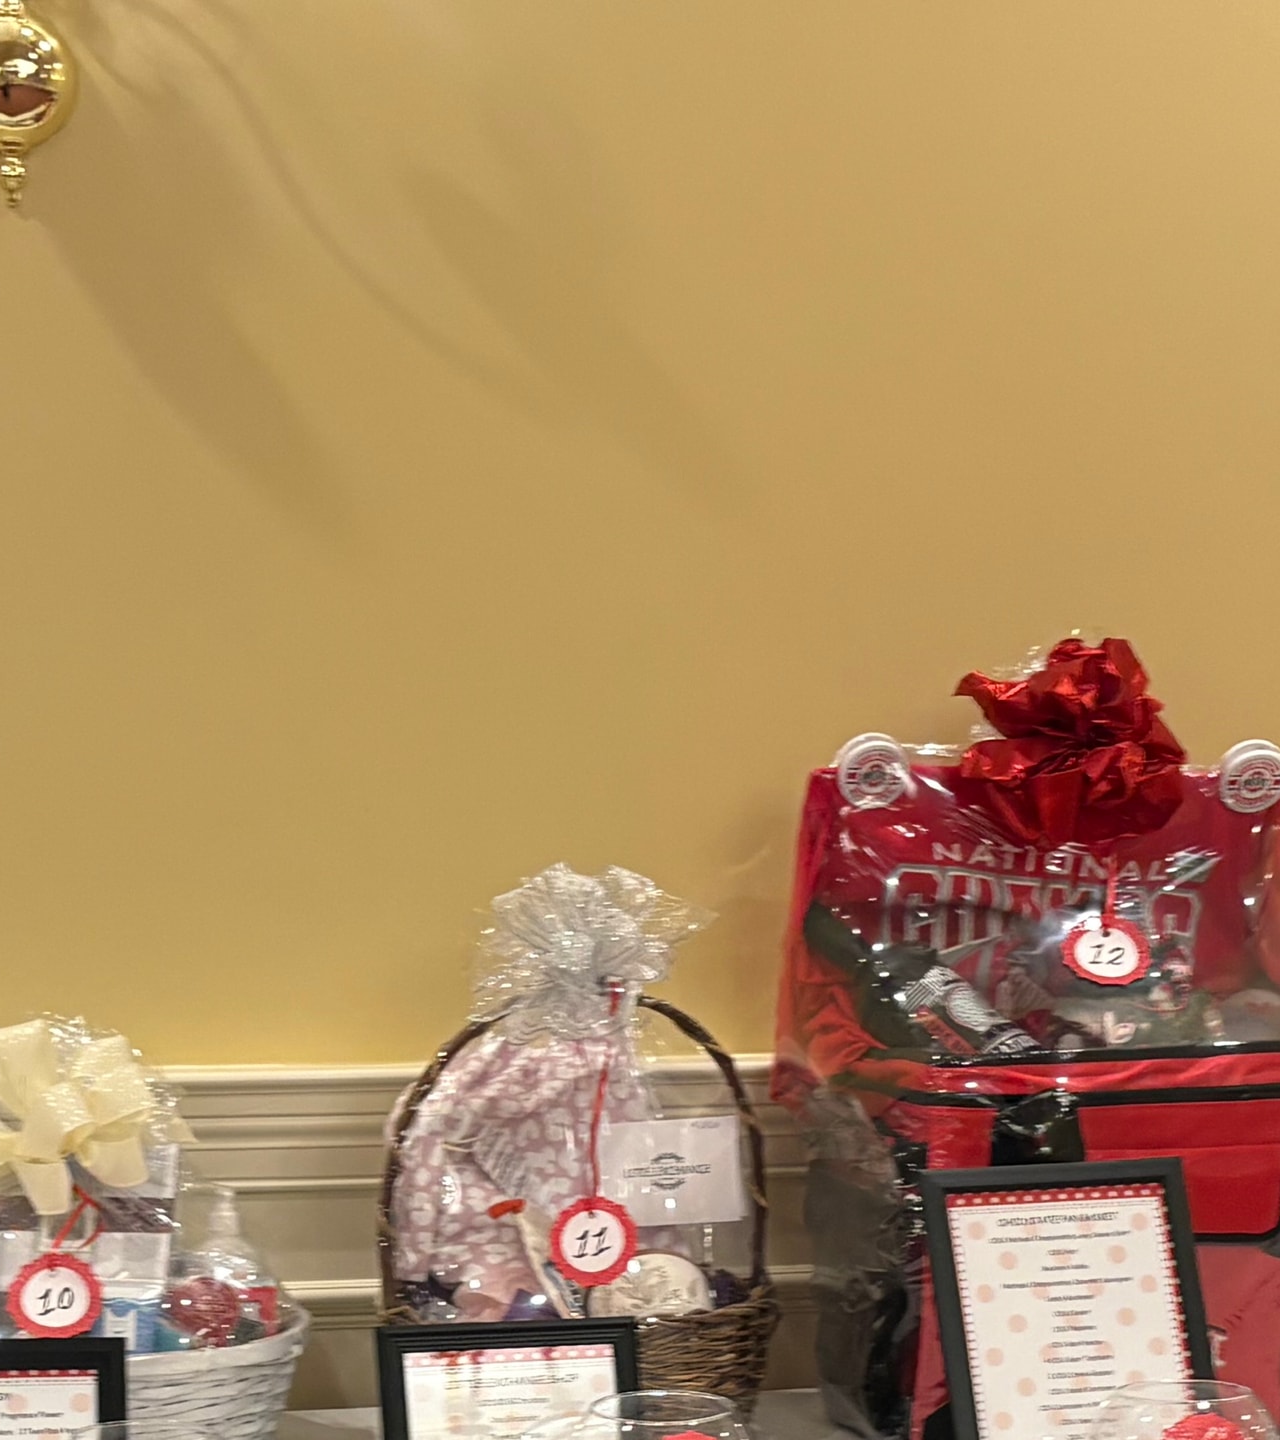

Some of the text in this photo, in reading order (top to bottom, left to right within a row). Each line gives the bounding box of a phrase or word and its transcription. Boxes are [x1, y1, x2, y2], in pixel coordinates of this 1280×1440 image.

[930, 842, 1167, 882] NATIONAL
[1088, 944, 1126, 965] 12
[572, 1226, 613, 1258] 11
[37, 1286, 75, 1316] 10
